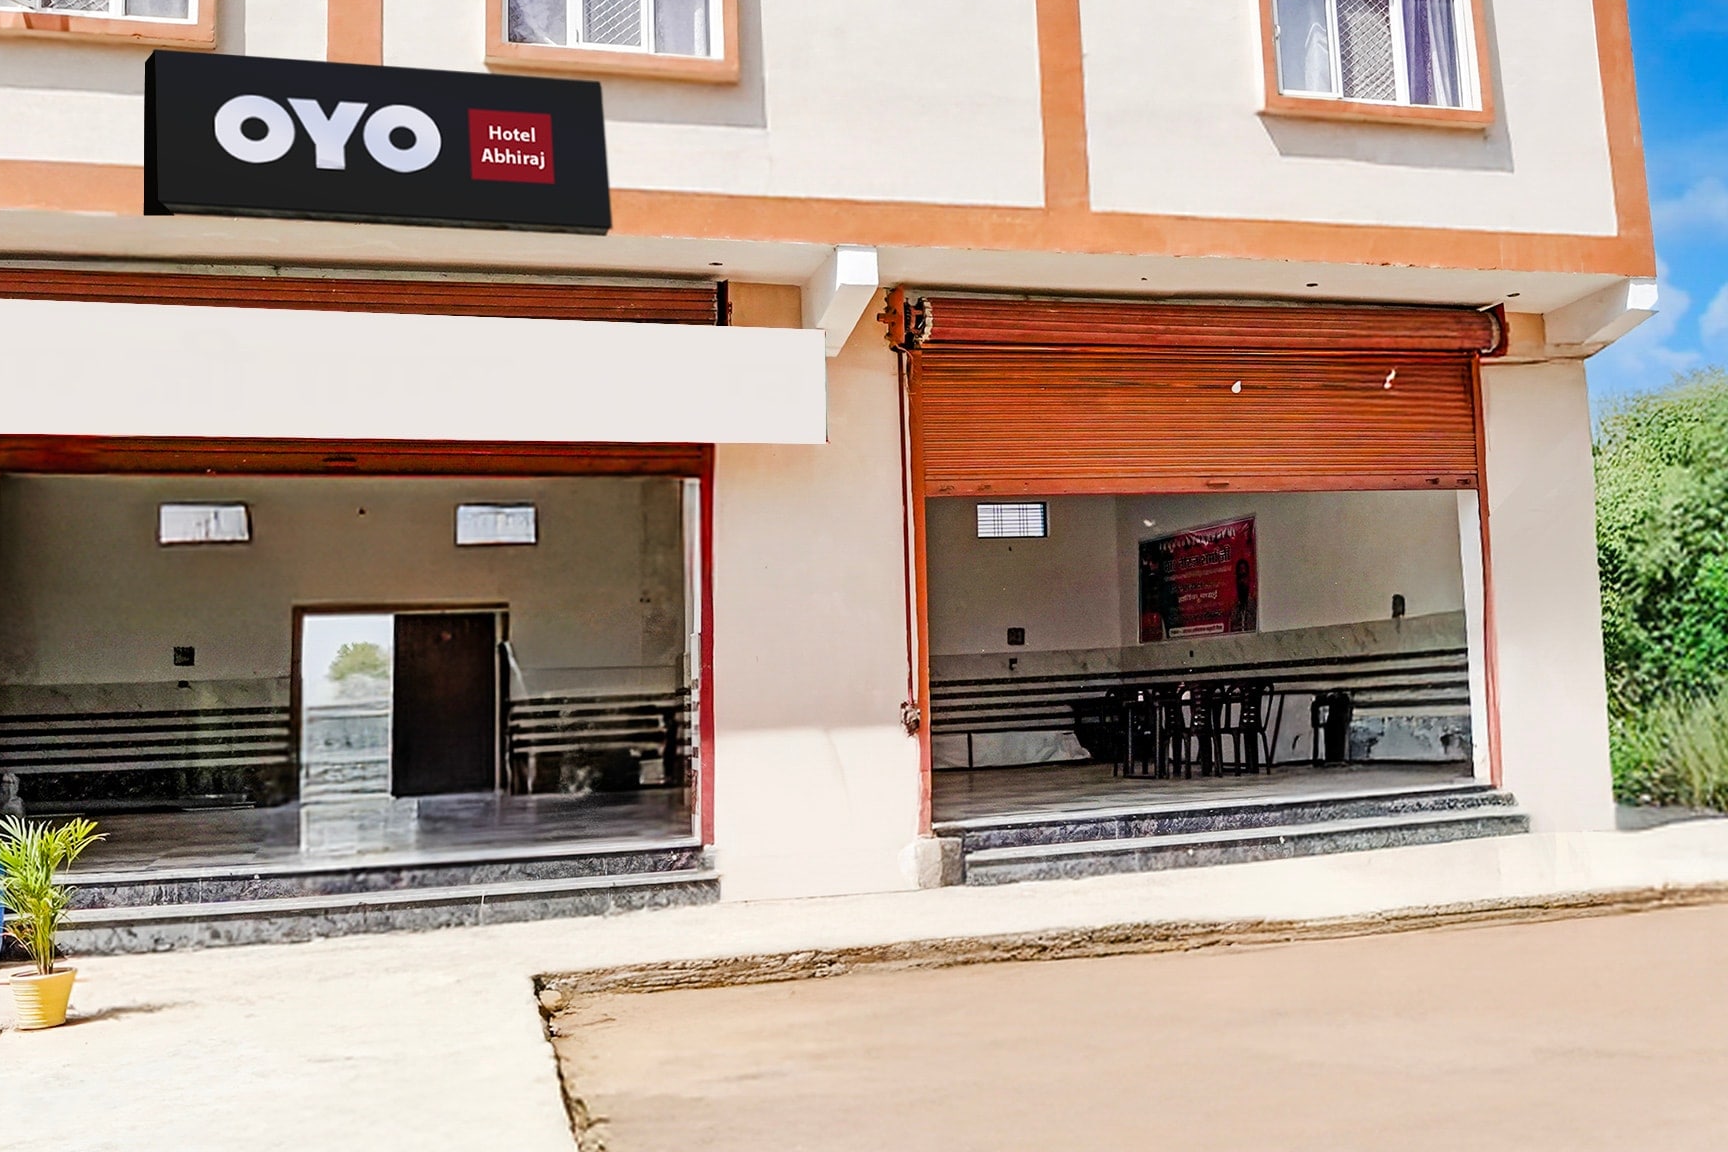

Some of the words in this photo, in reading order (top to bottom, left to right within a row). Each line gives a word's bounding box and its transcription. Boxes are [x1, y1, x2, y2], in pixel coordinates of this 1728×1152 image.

[214, 94, 443, 173] OYO
[487, 125, 537, 144] Hotel
[480, 148, 547, 171] Abhiraj
